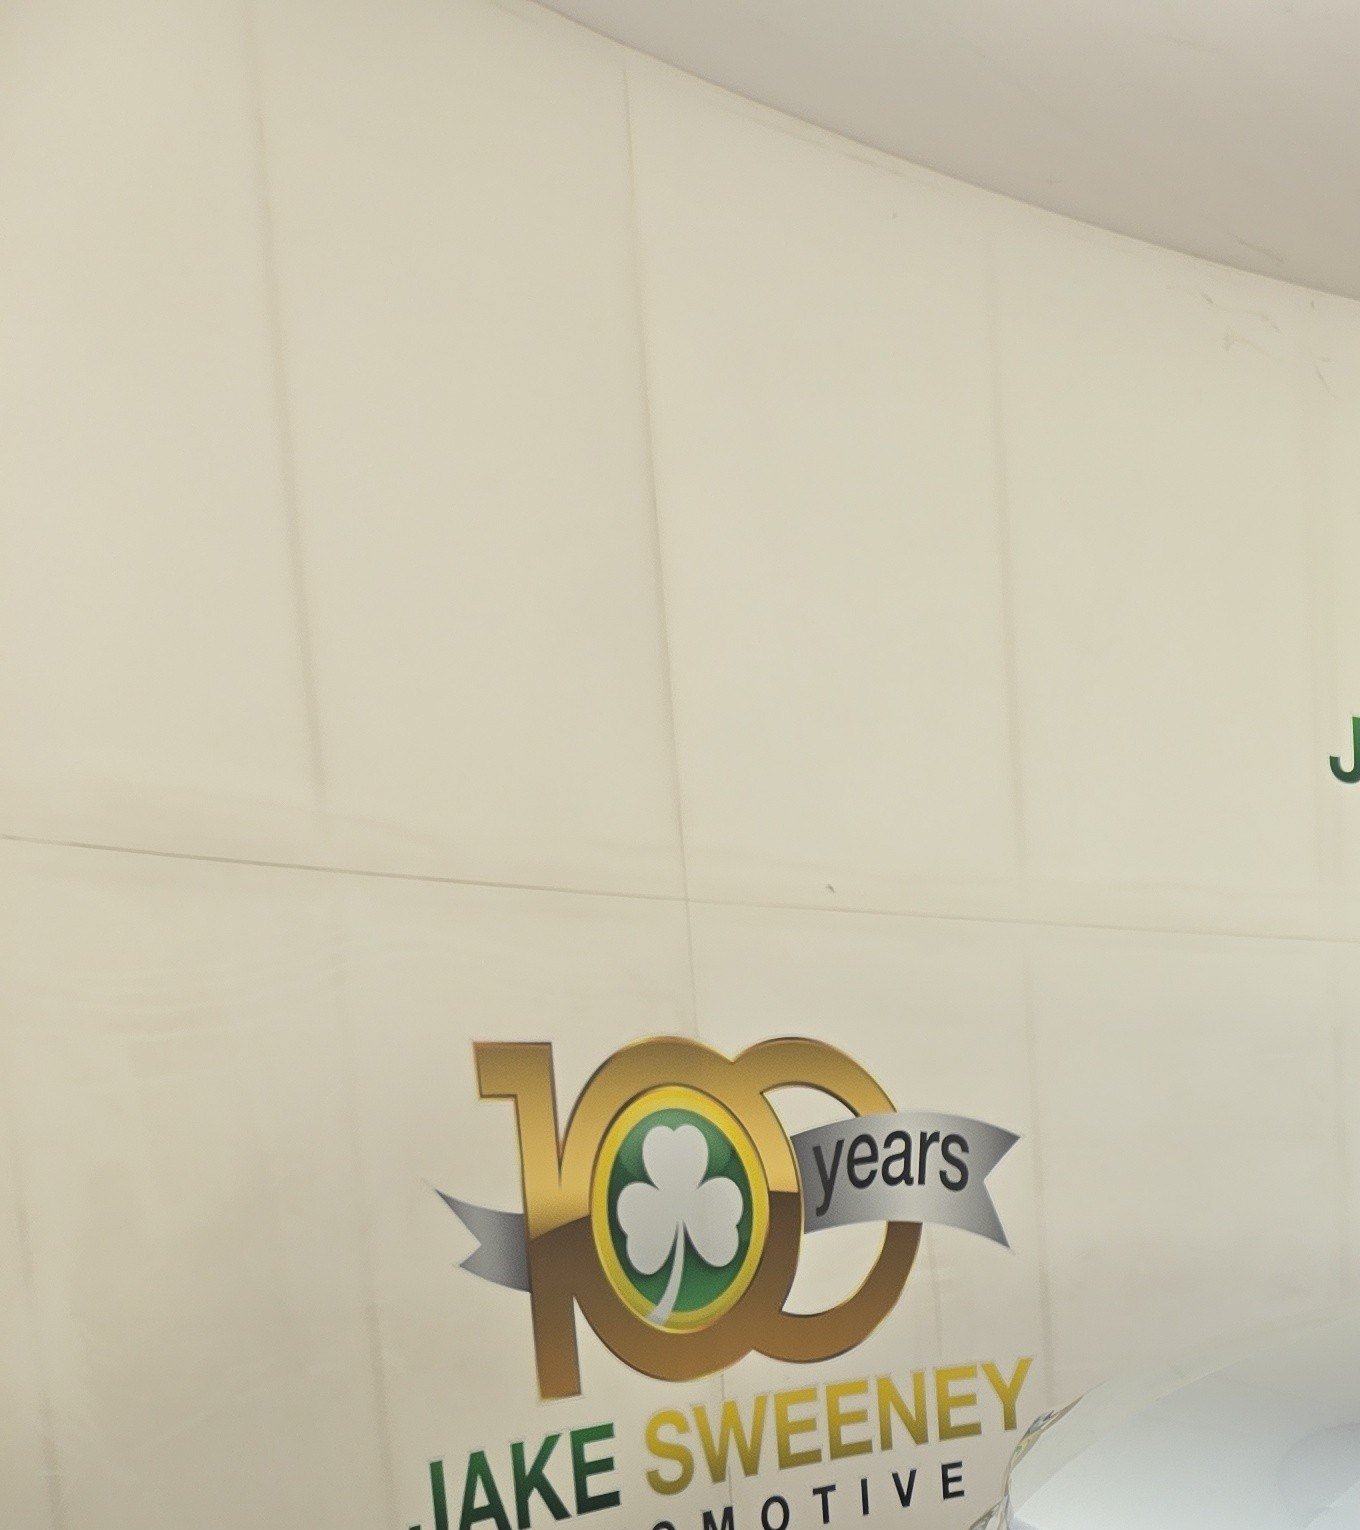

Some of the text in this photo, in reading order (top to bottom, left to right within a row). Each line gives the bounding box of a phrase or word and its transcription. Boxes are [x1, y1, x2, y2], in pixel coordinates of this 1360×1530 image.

[472, 1035, 923, 1400] 100
[812, 1129, 971, 1217] years
[644, 1358, 1034, 1497] SWEENEY
